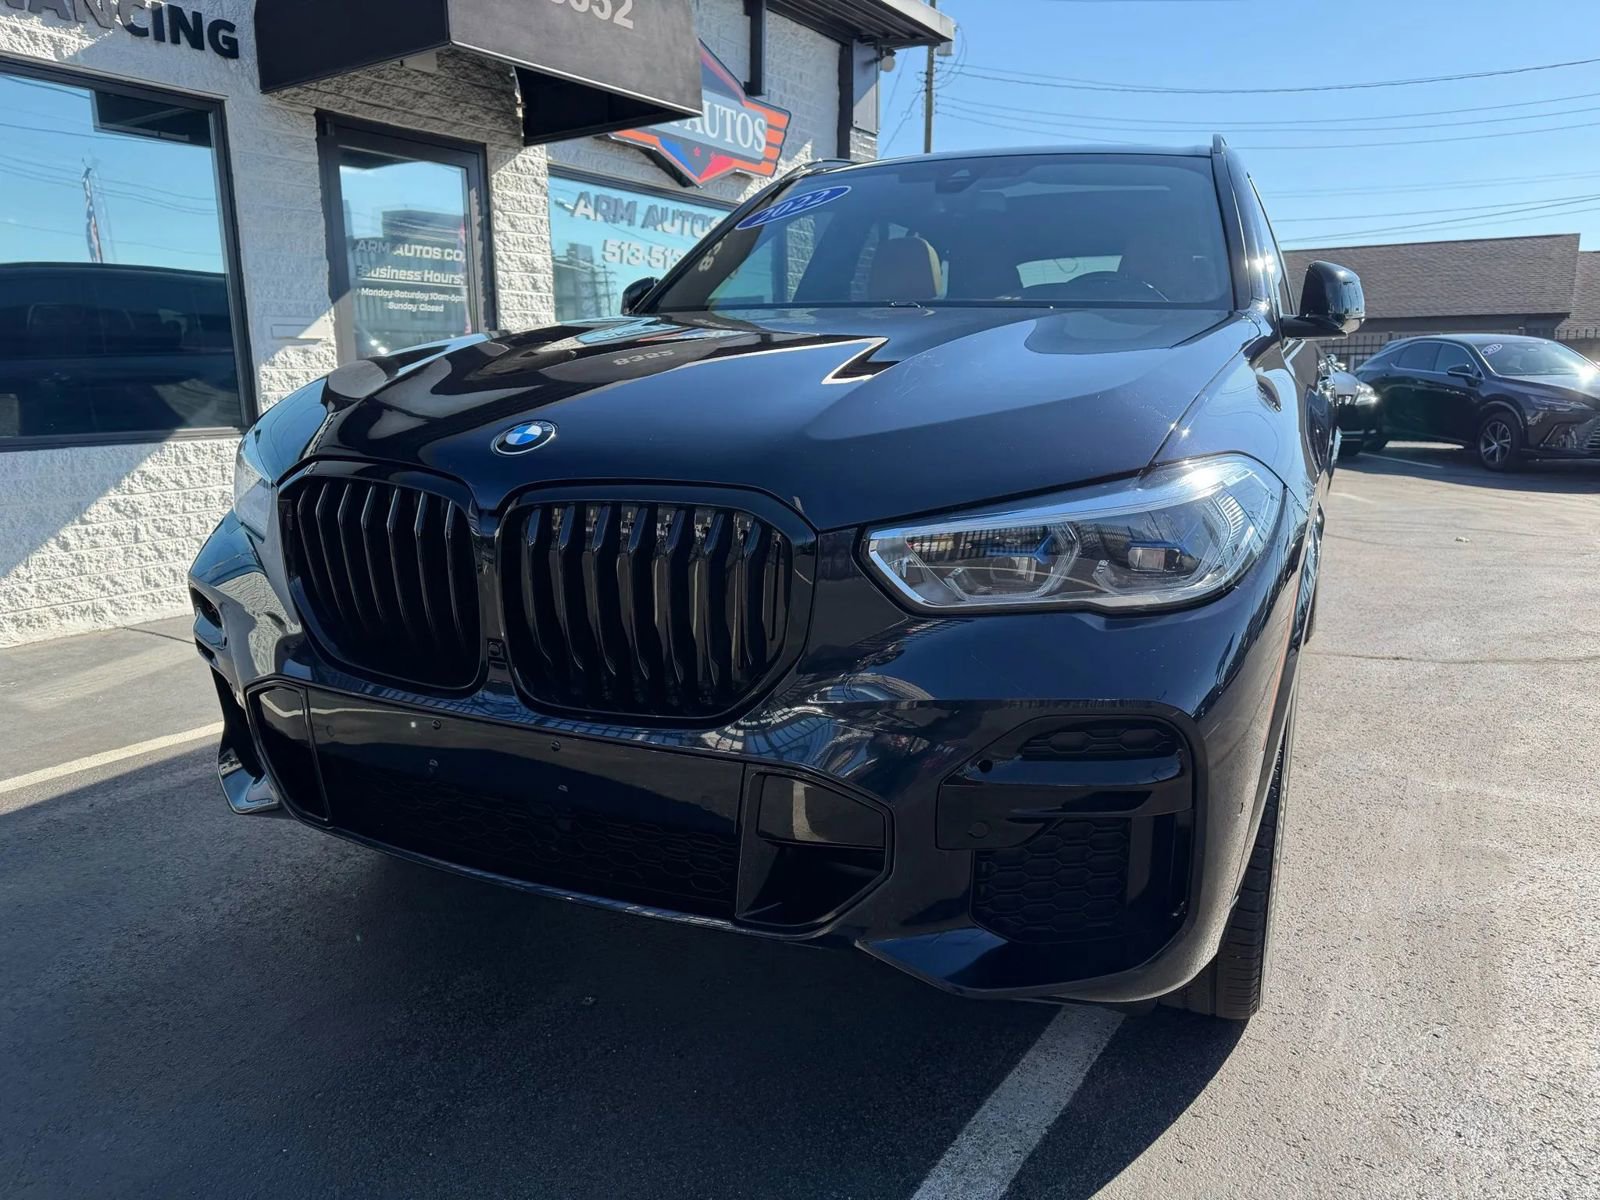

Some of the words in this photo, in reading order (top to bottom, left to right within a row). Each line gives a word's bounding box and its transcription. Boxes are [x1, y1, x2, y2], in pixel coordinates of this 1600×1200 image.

[6, 0, 239, 59] NCING
[573, 191, 637, 227] ARM
[355, 240, 390, 254] ARM
[392, 244, 442, 260] AUTOS
[360, 264, 421, 281] Business
